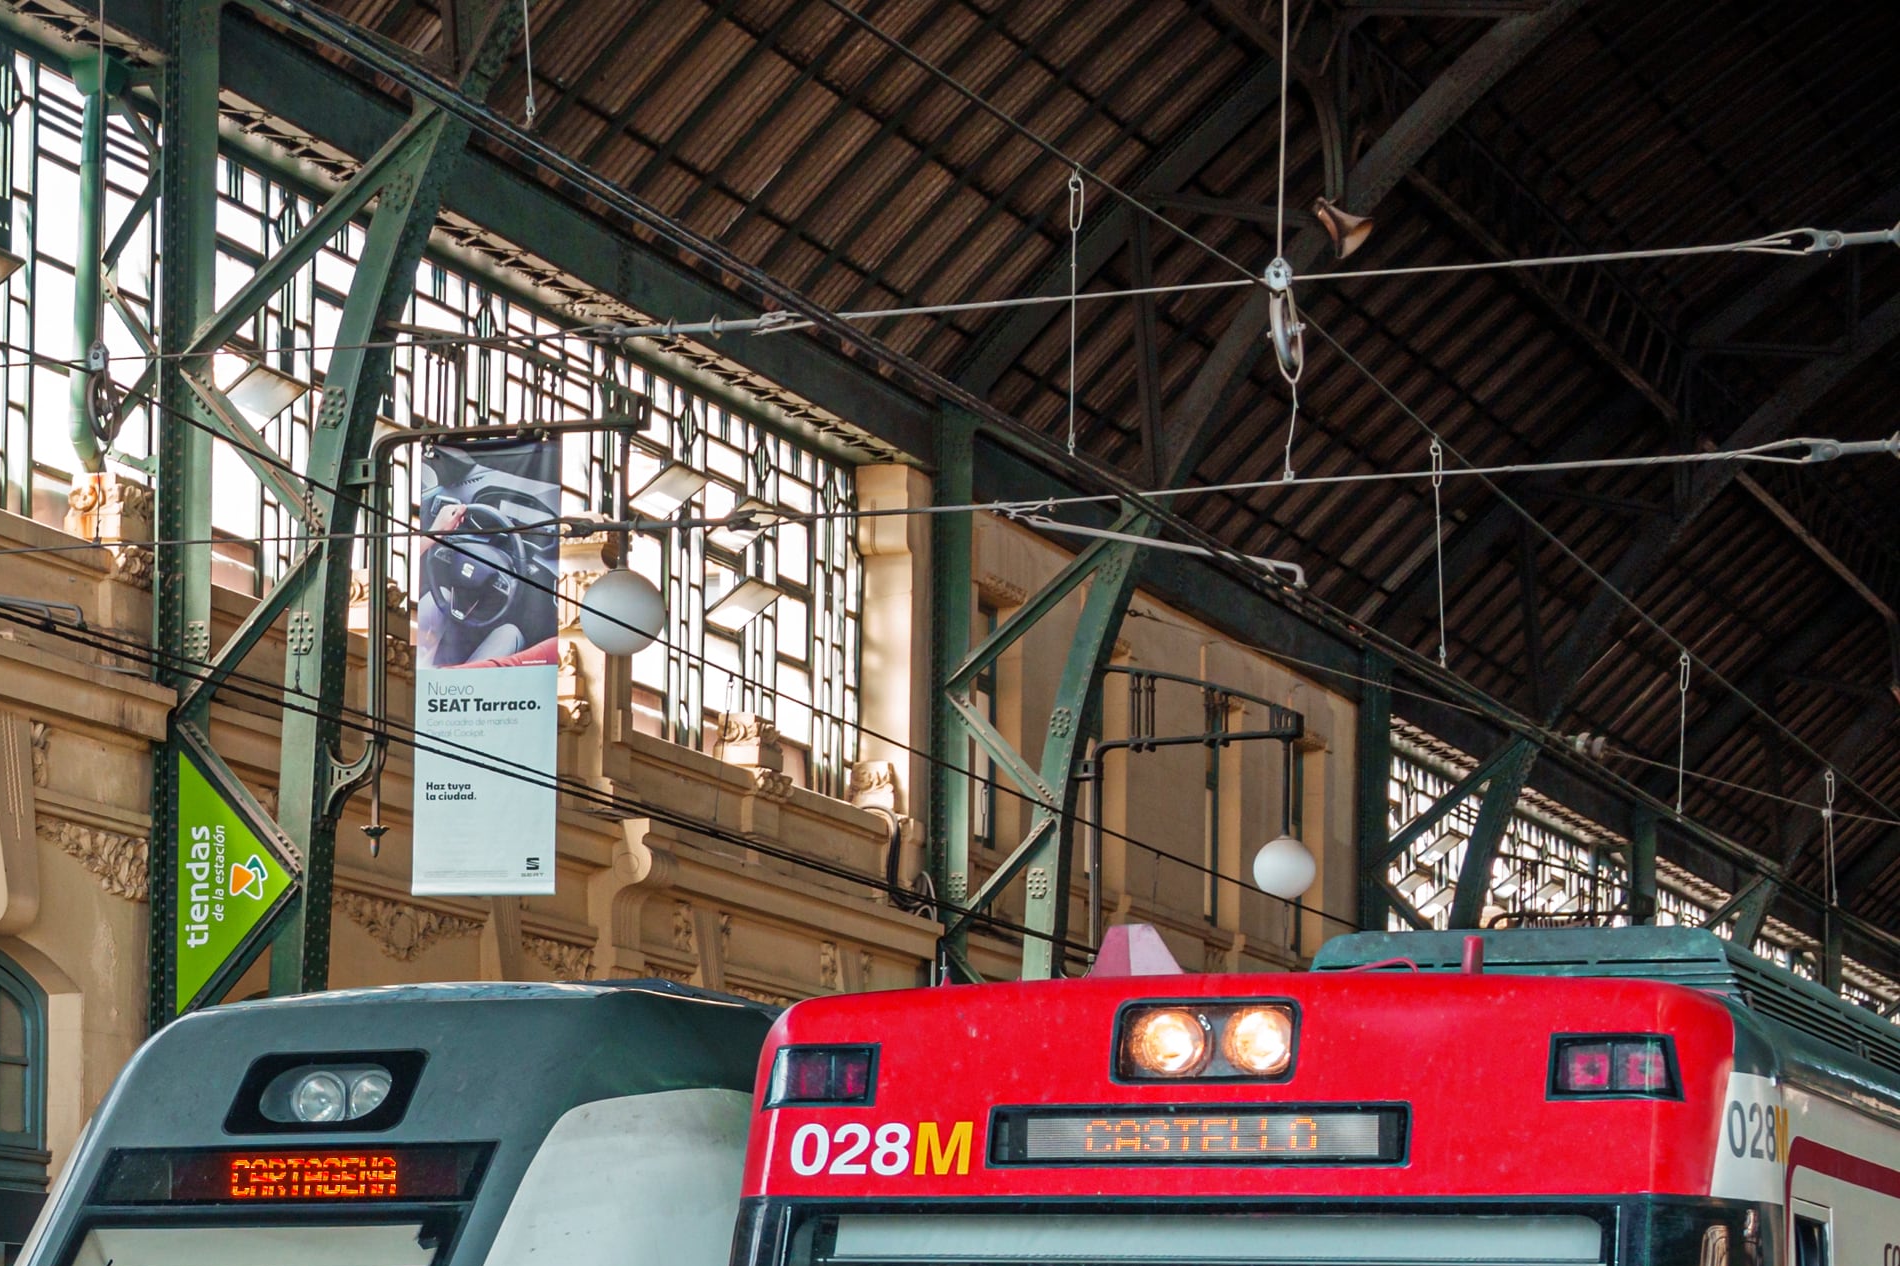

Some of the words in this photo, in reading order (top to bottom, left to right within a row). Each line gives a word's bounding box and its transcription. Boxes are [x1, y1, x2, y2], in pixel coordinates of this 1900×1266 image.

[427, 681, 474, 696] Nuevo
[427, 699, 471, 713] SEAT
[473, 698, 541, 712] Tarraco.
[425, 782, 446, 791] Haz
[447, 782, 471, 792] tuya
[425, 792, 436, 801] la
[438, 792, 477, 801] ciudad.
[213, 824, 226, 884] estación
[185, 825, 211, 949] tiendas
[212, 888, 225, 900] la
[212, 903, 225, 922] de
[1084, 1117, 1318, 1153] CASTELLO
[1727, 1100, 1790, 1166] 028M
[789, 1120, 974, 1177] 028M
